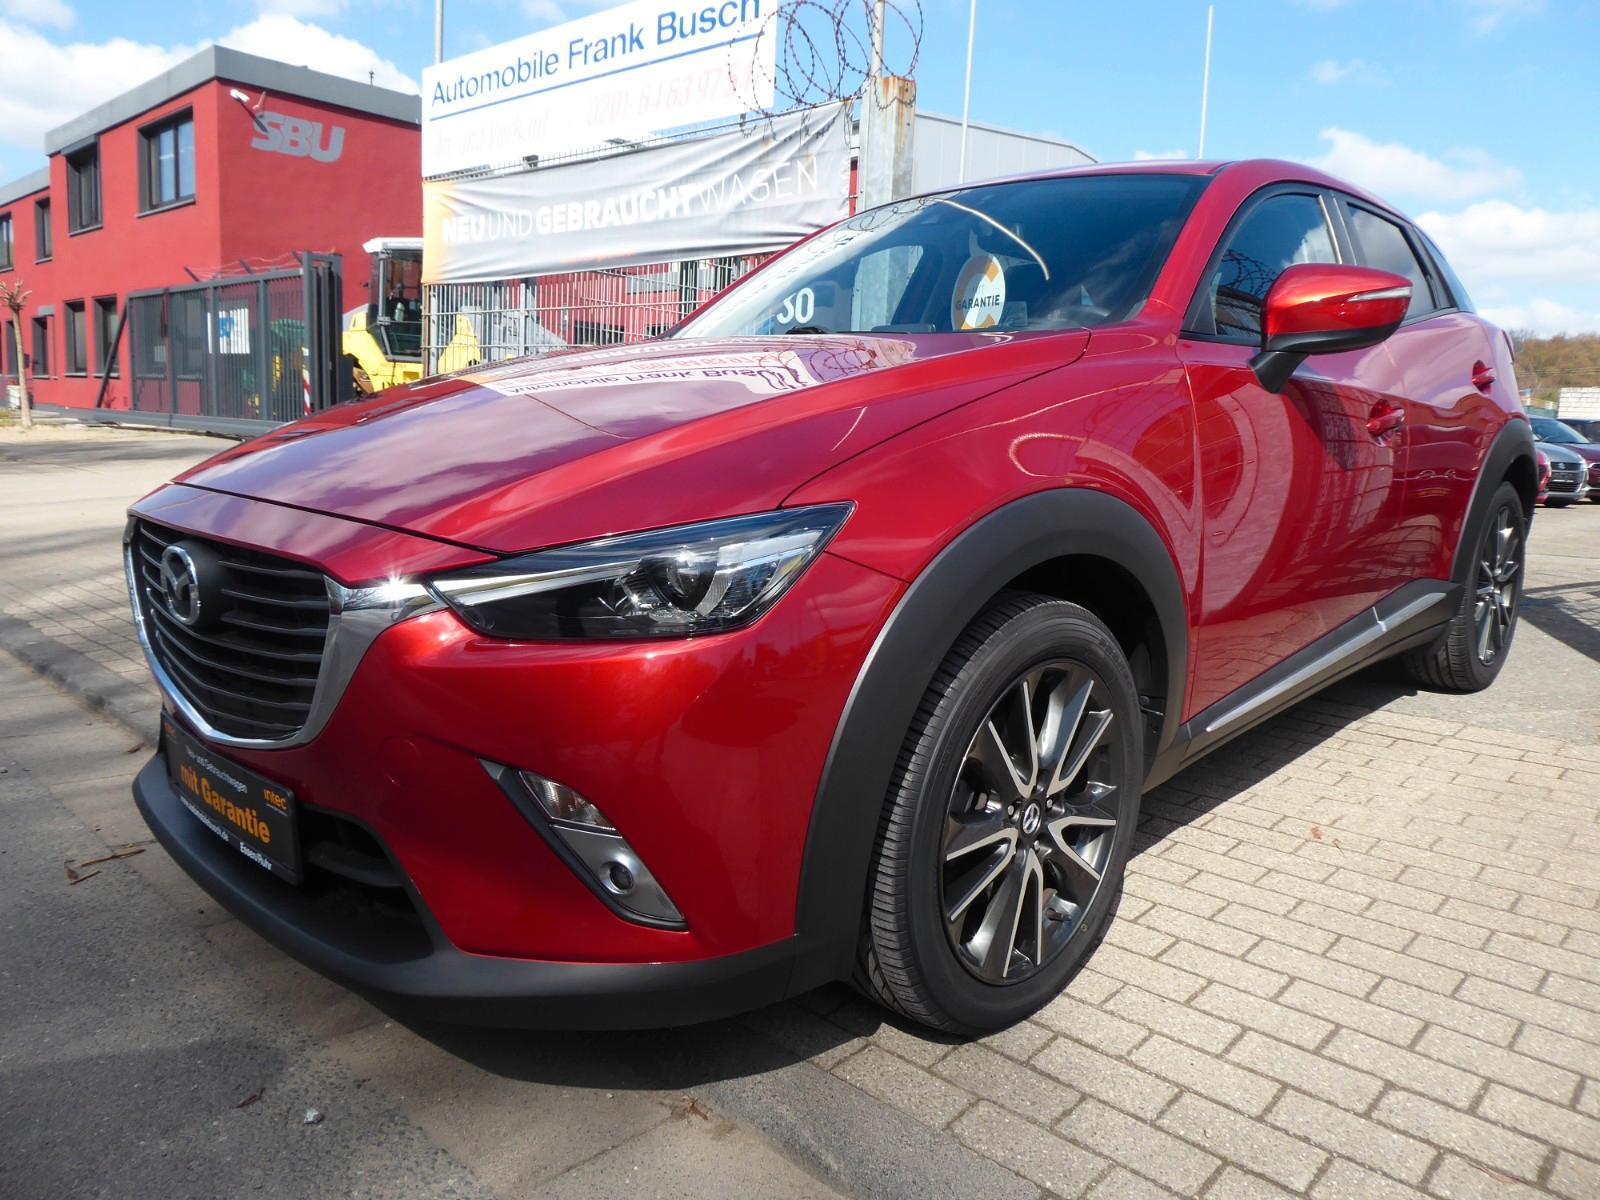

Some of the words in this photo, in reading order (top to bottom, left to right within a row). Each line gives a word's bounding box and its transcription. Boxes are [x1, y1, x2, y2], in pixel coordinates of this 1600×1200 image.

[431, 50, 559, 107] Automobile
[568, 29, 645, 70] Frank
[250, 110, 346, 163] SBU
[956, 294, 1000, 311] GARANTIE
[180, 764, 199, 795] mit
[201, 778, 272, 844] Garantie
